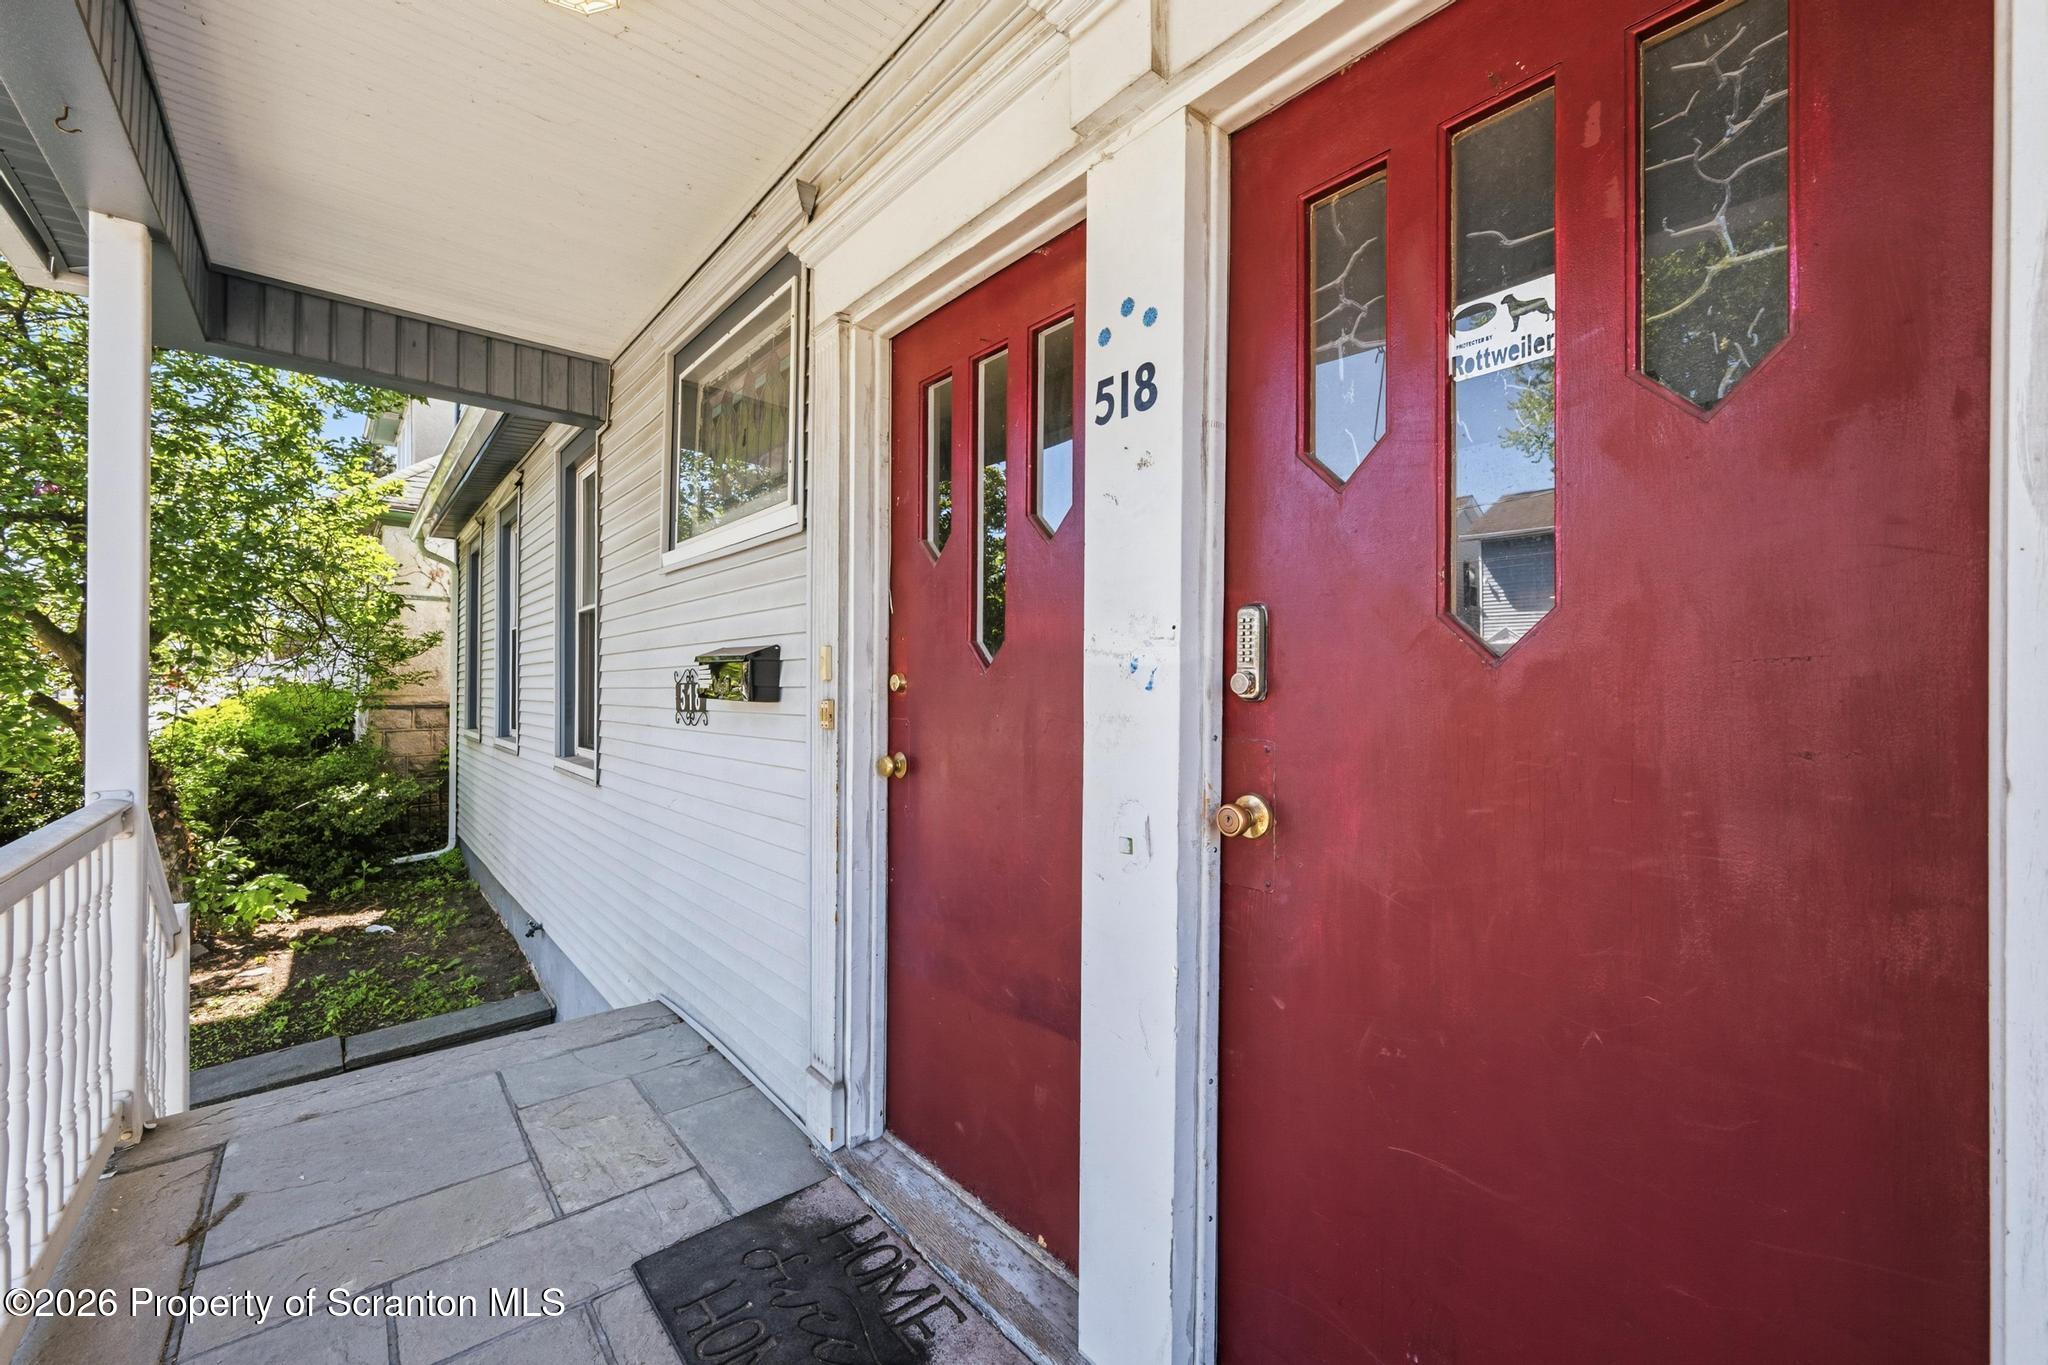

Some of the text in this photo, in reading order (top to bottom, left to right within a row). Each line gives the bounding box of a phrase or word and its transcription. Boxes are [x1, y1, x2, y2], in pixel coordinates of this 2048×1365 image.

[1452, 333, 1555, 377] Rottweiler
[1456, 338, 1485, 350] PROTECTED
[1095, 362, 1158, 426] 518
[680, 684, 701, 711] 518
[817, 1213, 968, 1356] HOME
